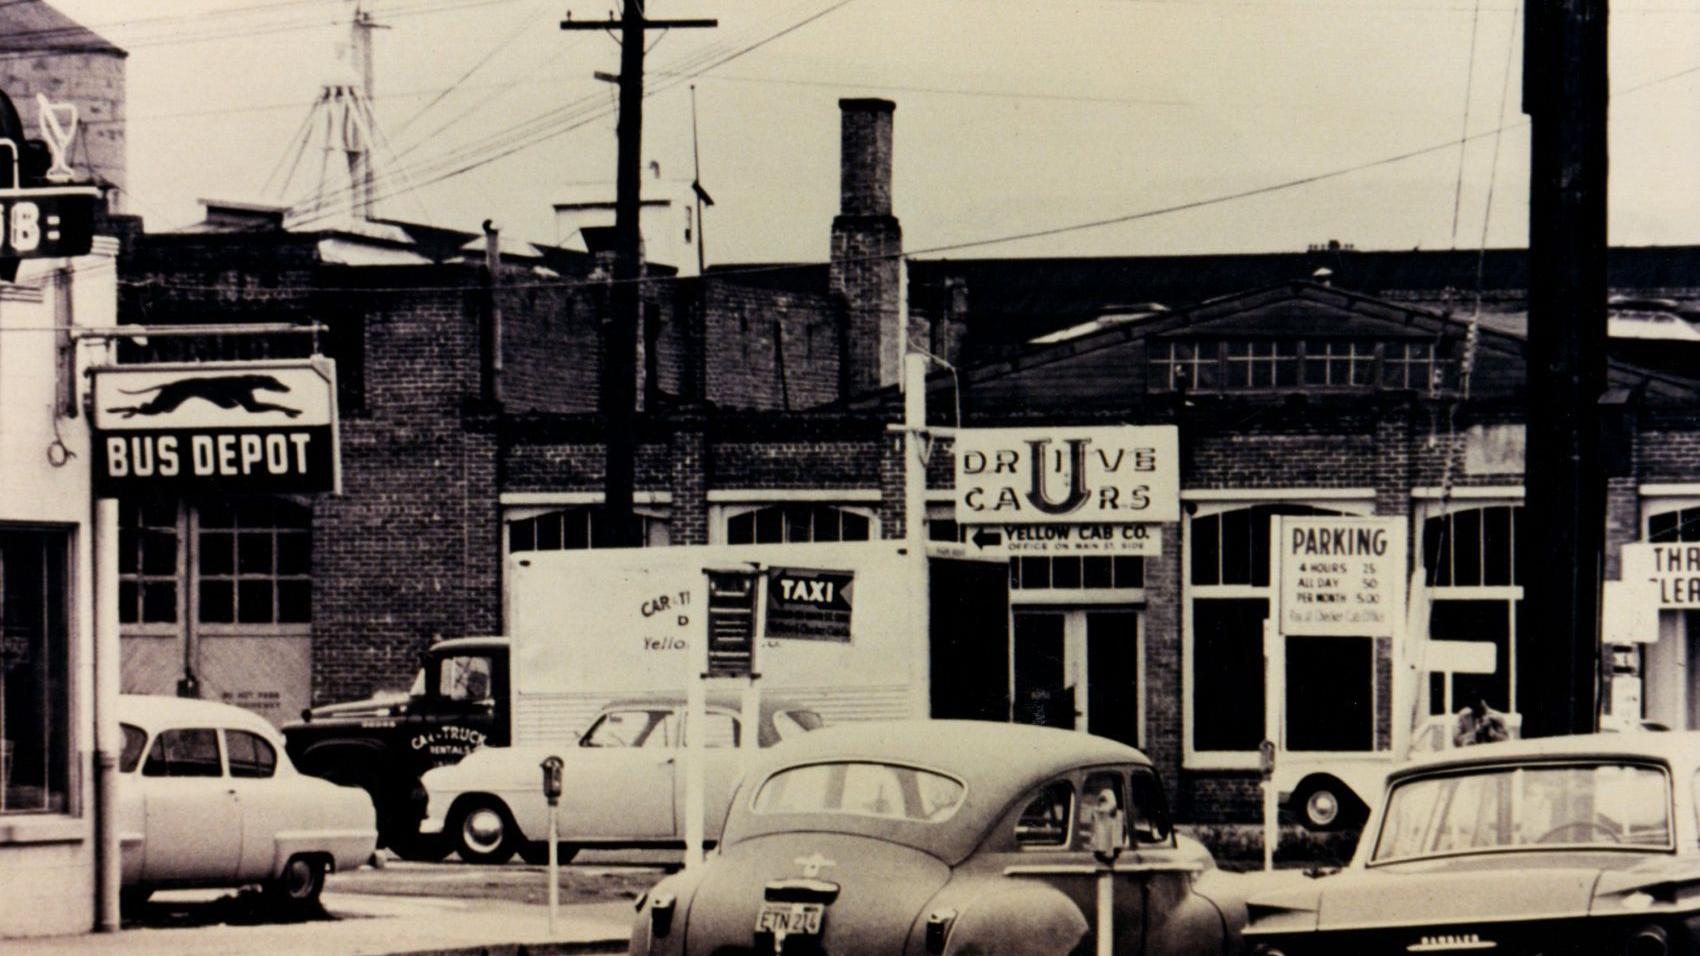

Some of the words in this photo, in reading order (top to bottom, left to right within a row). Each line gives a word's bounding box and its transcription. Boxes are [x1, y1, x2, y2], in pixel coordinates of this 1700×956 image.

[106, 435, 180, 478] BUS
[191, 433, 311, 476] DEPOT
[1004, 523, 1071, 541] YELLOW
[1078, 523, 1114, 541] CAB
[1121, 523, 1151, 541] CO.
[1008, 542, 1048, 551] OFFICE
[1055, 542, 1070, 550] ON
[1075, 542, 1100, 550] MAIN
[1121, 542, 1145, 550] SIDE
[1292, 527, 1388, 556] PARKING
[1299, 562, 1307, 572] 4
[1310, 562, 1347, 573] HOURS
[1298, 578, 1314, 588] ALL
[1318, 578, 1338, 588] DAY
[781, 579, 833, 602] TAXI
[1297, 593, 1313, 603] PER
[1315, 593, 1347, 604] MONTH
[429, 745, 470, 755] RENTALS
[760, 911, 790, 930] ETN
